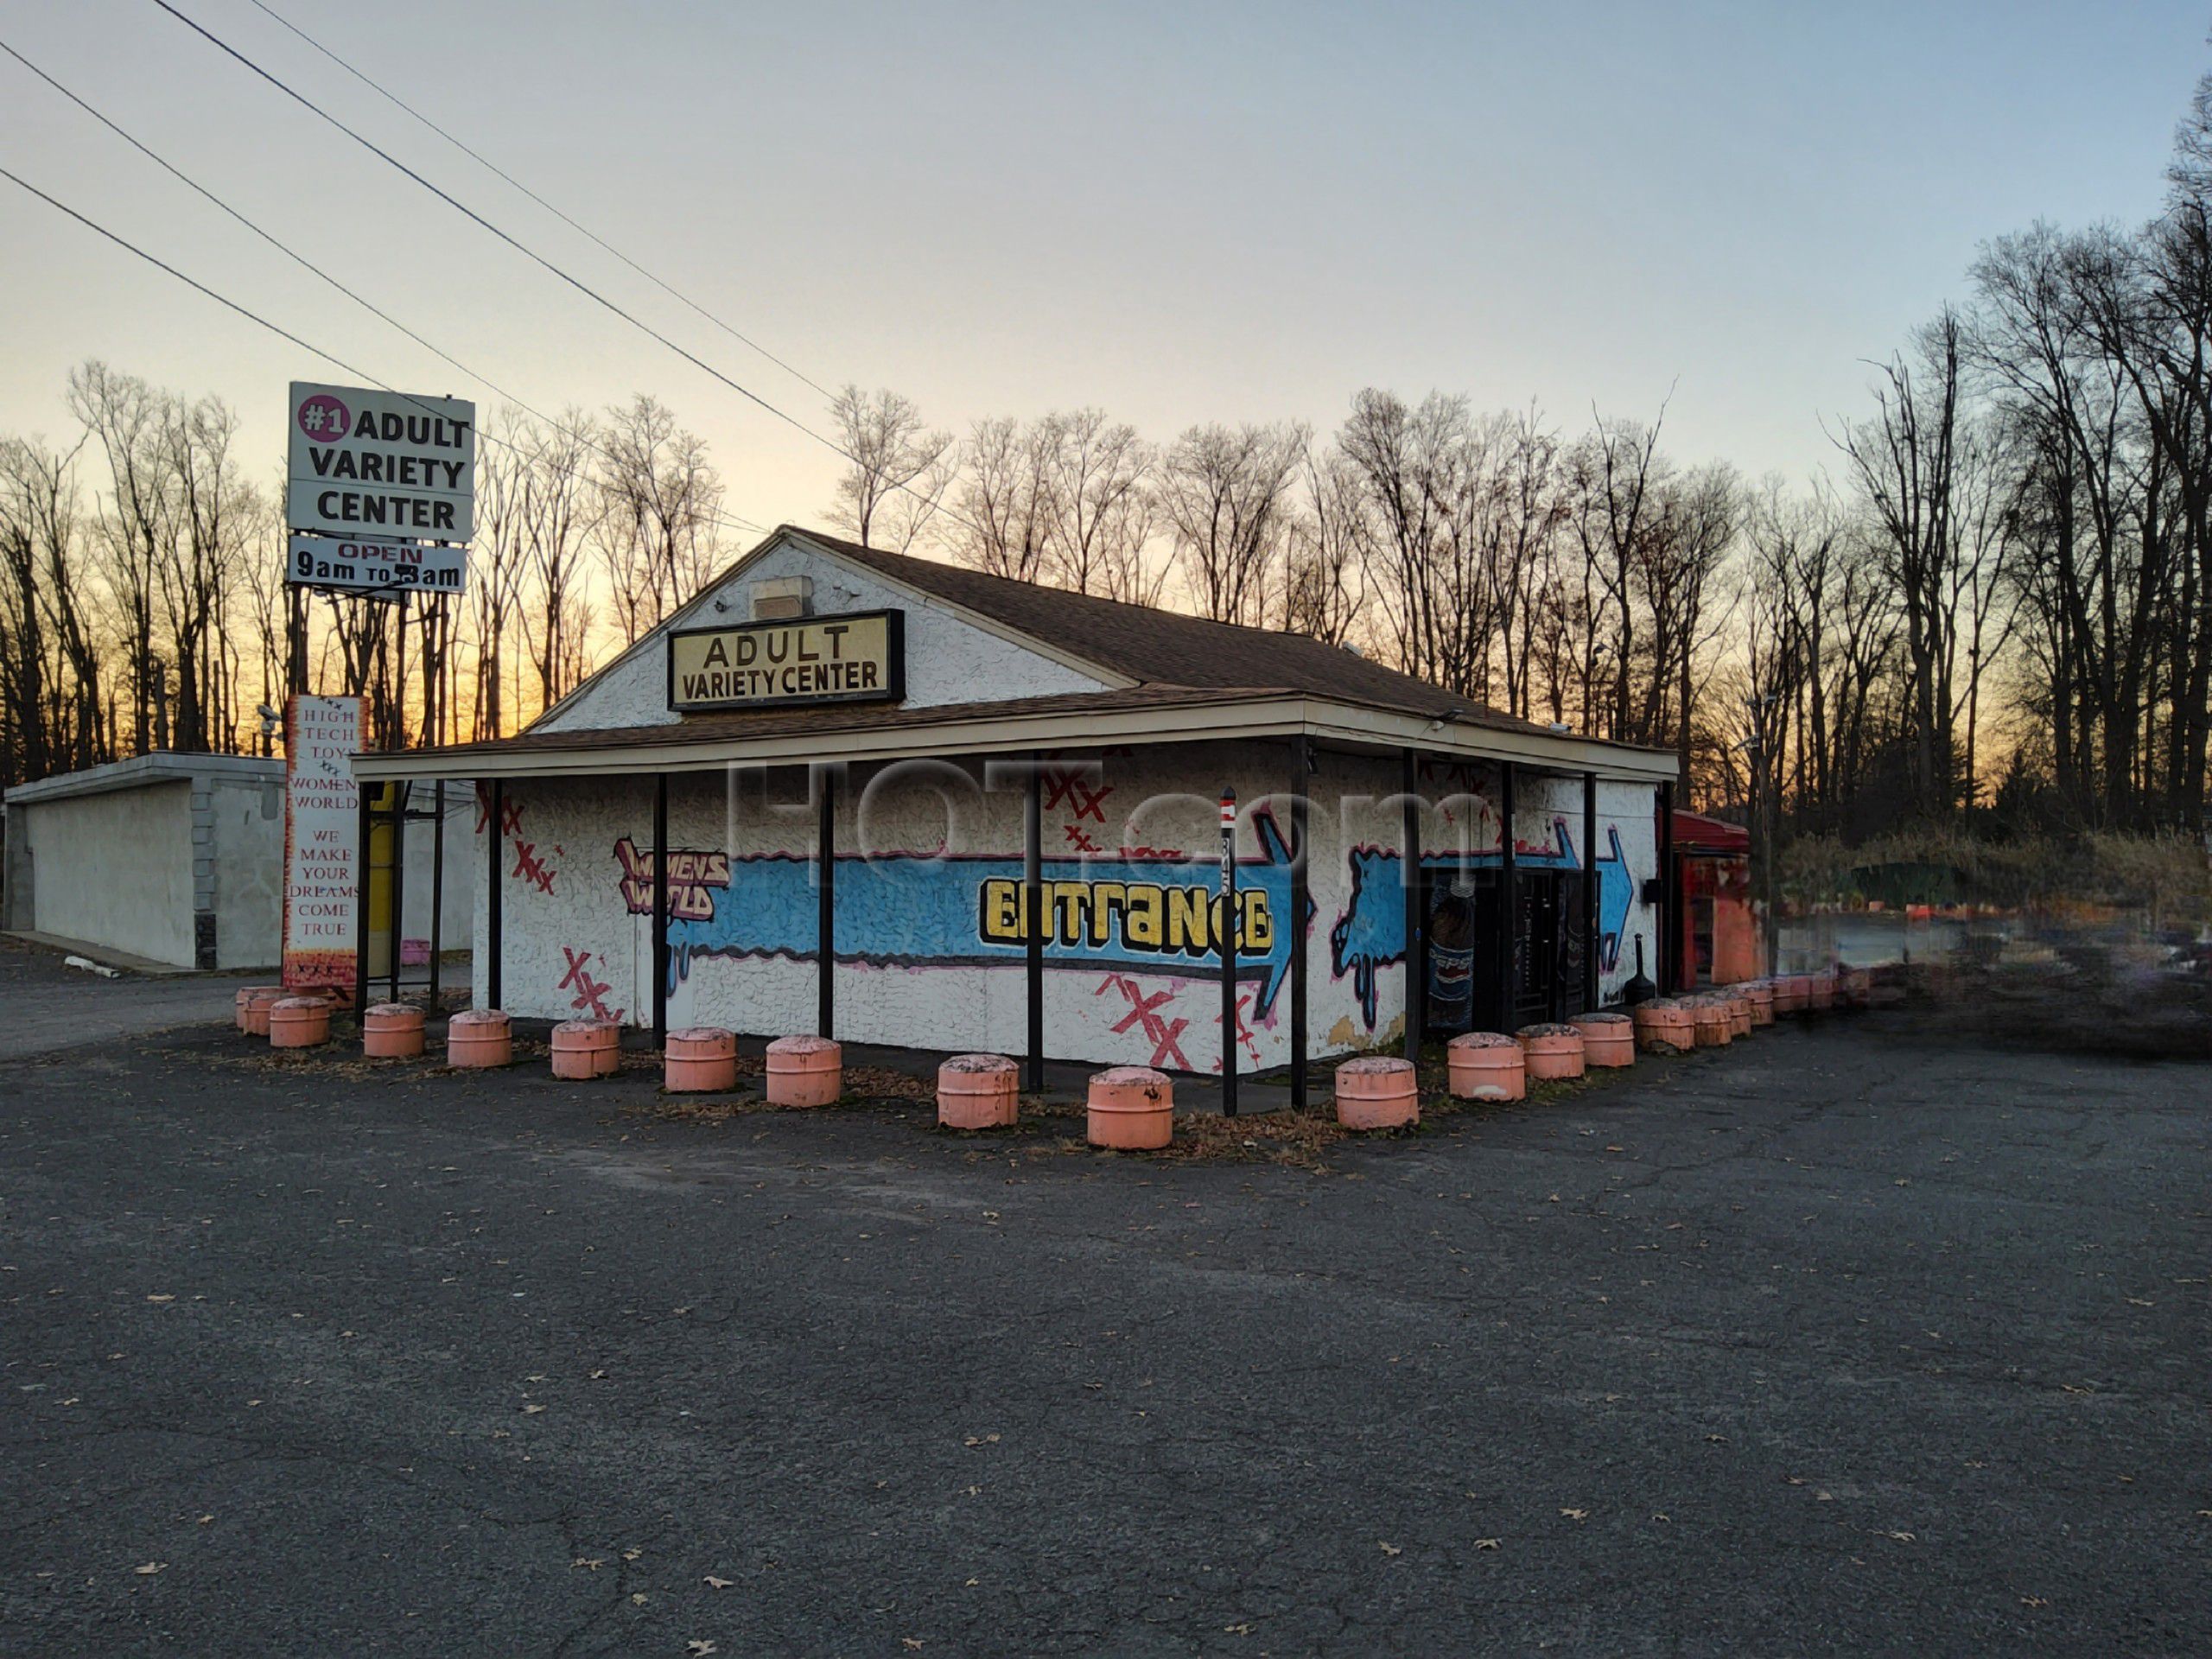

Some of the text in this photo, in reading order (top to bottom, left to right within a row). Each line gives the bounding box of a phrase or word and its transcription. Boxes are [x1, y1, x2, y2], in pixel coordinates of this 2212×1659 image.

[304, 404, 469, 448] #1 ADULT
[308, 447, 465, 489] VARIETY
[317, 490, 454, 530] CENTER
[338, 543, 422, 564] OPEN
[297, 550, 354, 579] 9am
[703, 626, 849, 669] ADULT
[683, 661, 877, 699] VARIETY CENTER
[304, 709, 354, 723] HIGH
[304, 727, 355, 741] TECH
[296, 796, 359, 810] WORLD
[313, 830, 340, 842] WE
[301, 849, 352, 861] MAKE
[302, 868, 349, 880] YOUR
[298, 904, 349, 917] COME
[302, 923, 347, 936] TRUE
